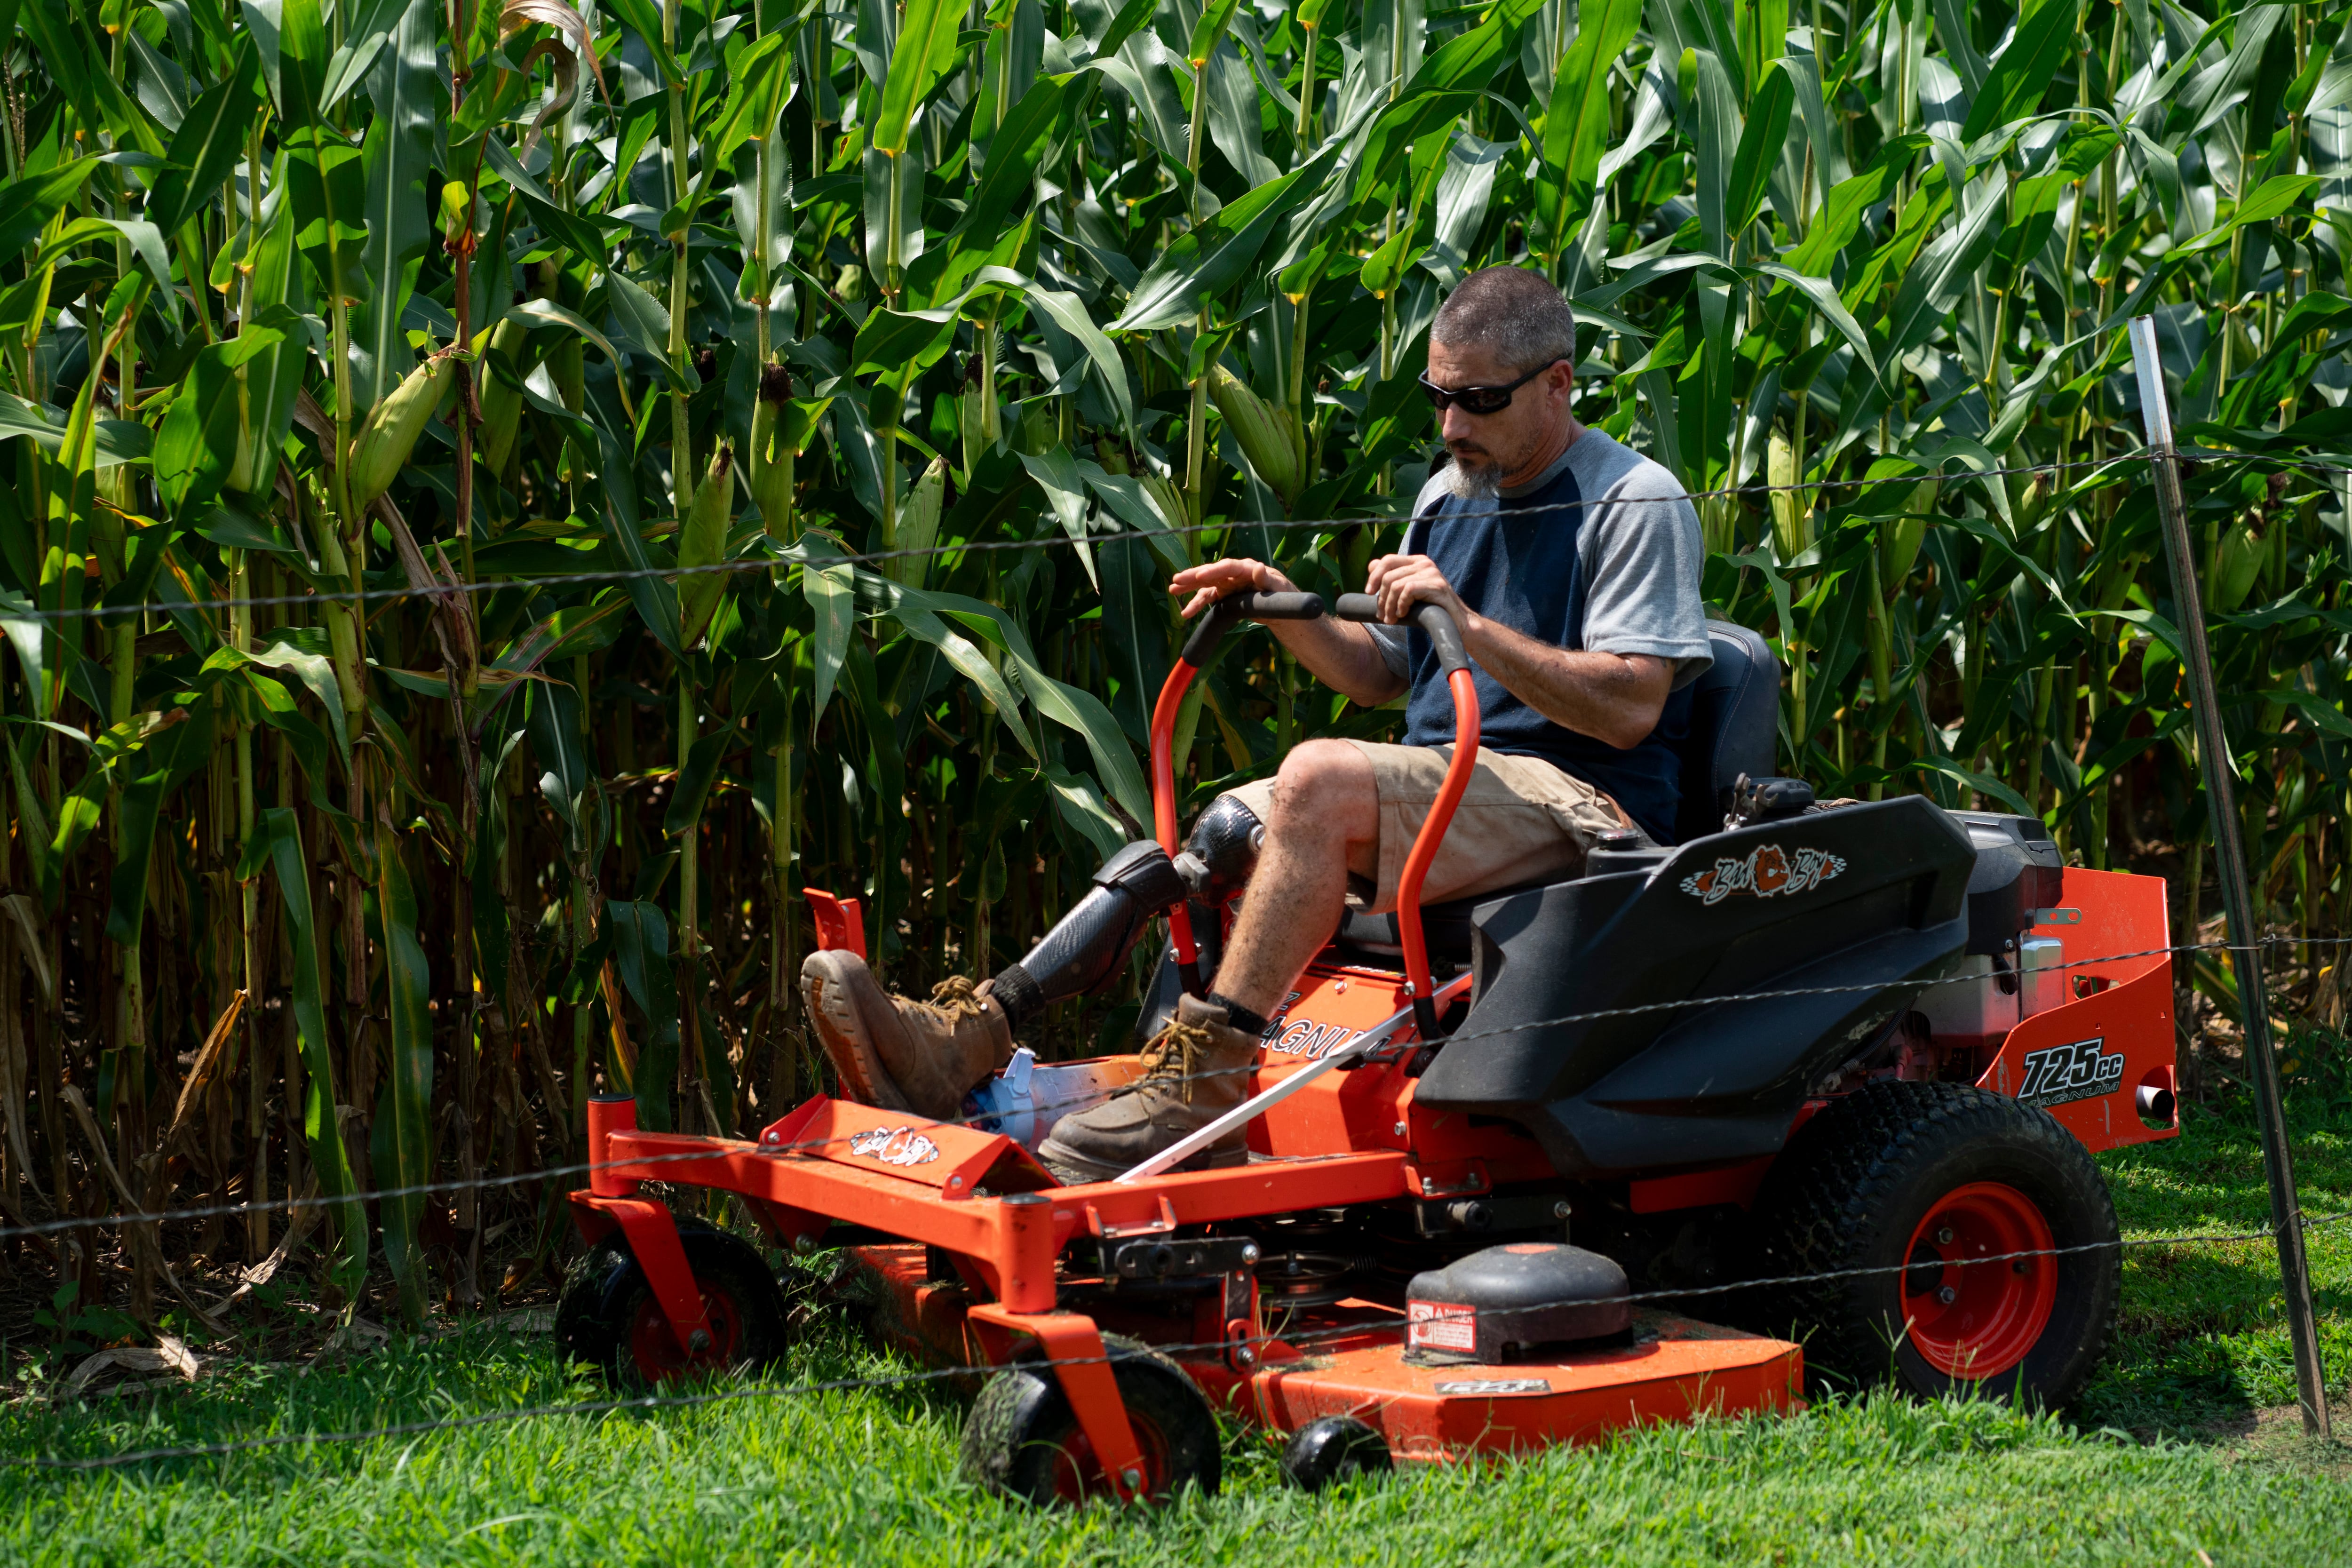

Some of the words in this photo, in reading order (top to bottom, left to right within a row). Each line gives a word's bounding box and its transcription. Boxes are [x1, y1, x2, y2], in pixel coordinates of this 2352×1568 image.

[1703, 852, 1757, 905] Bad
[1785, 847, 1828, 895] Boy
[1259, 1015, 1391, 1067] AGNU
[1444, 1308, 1473, 1324] DANGER
